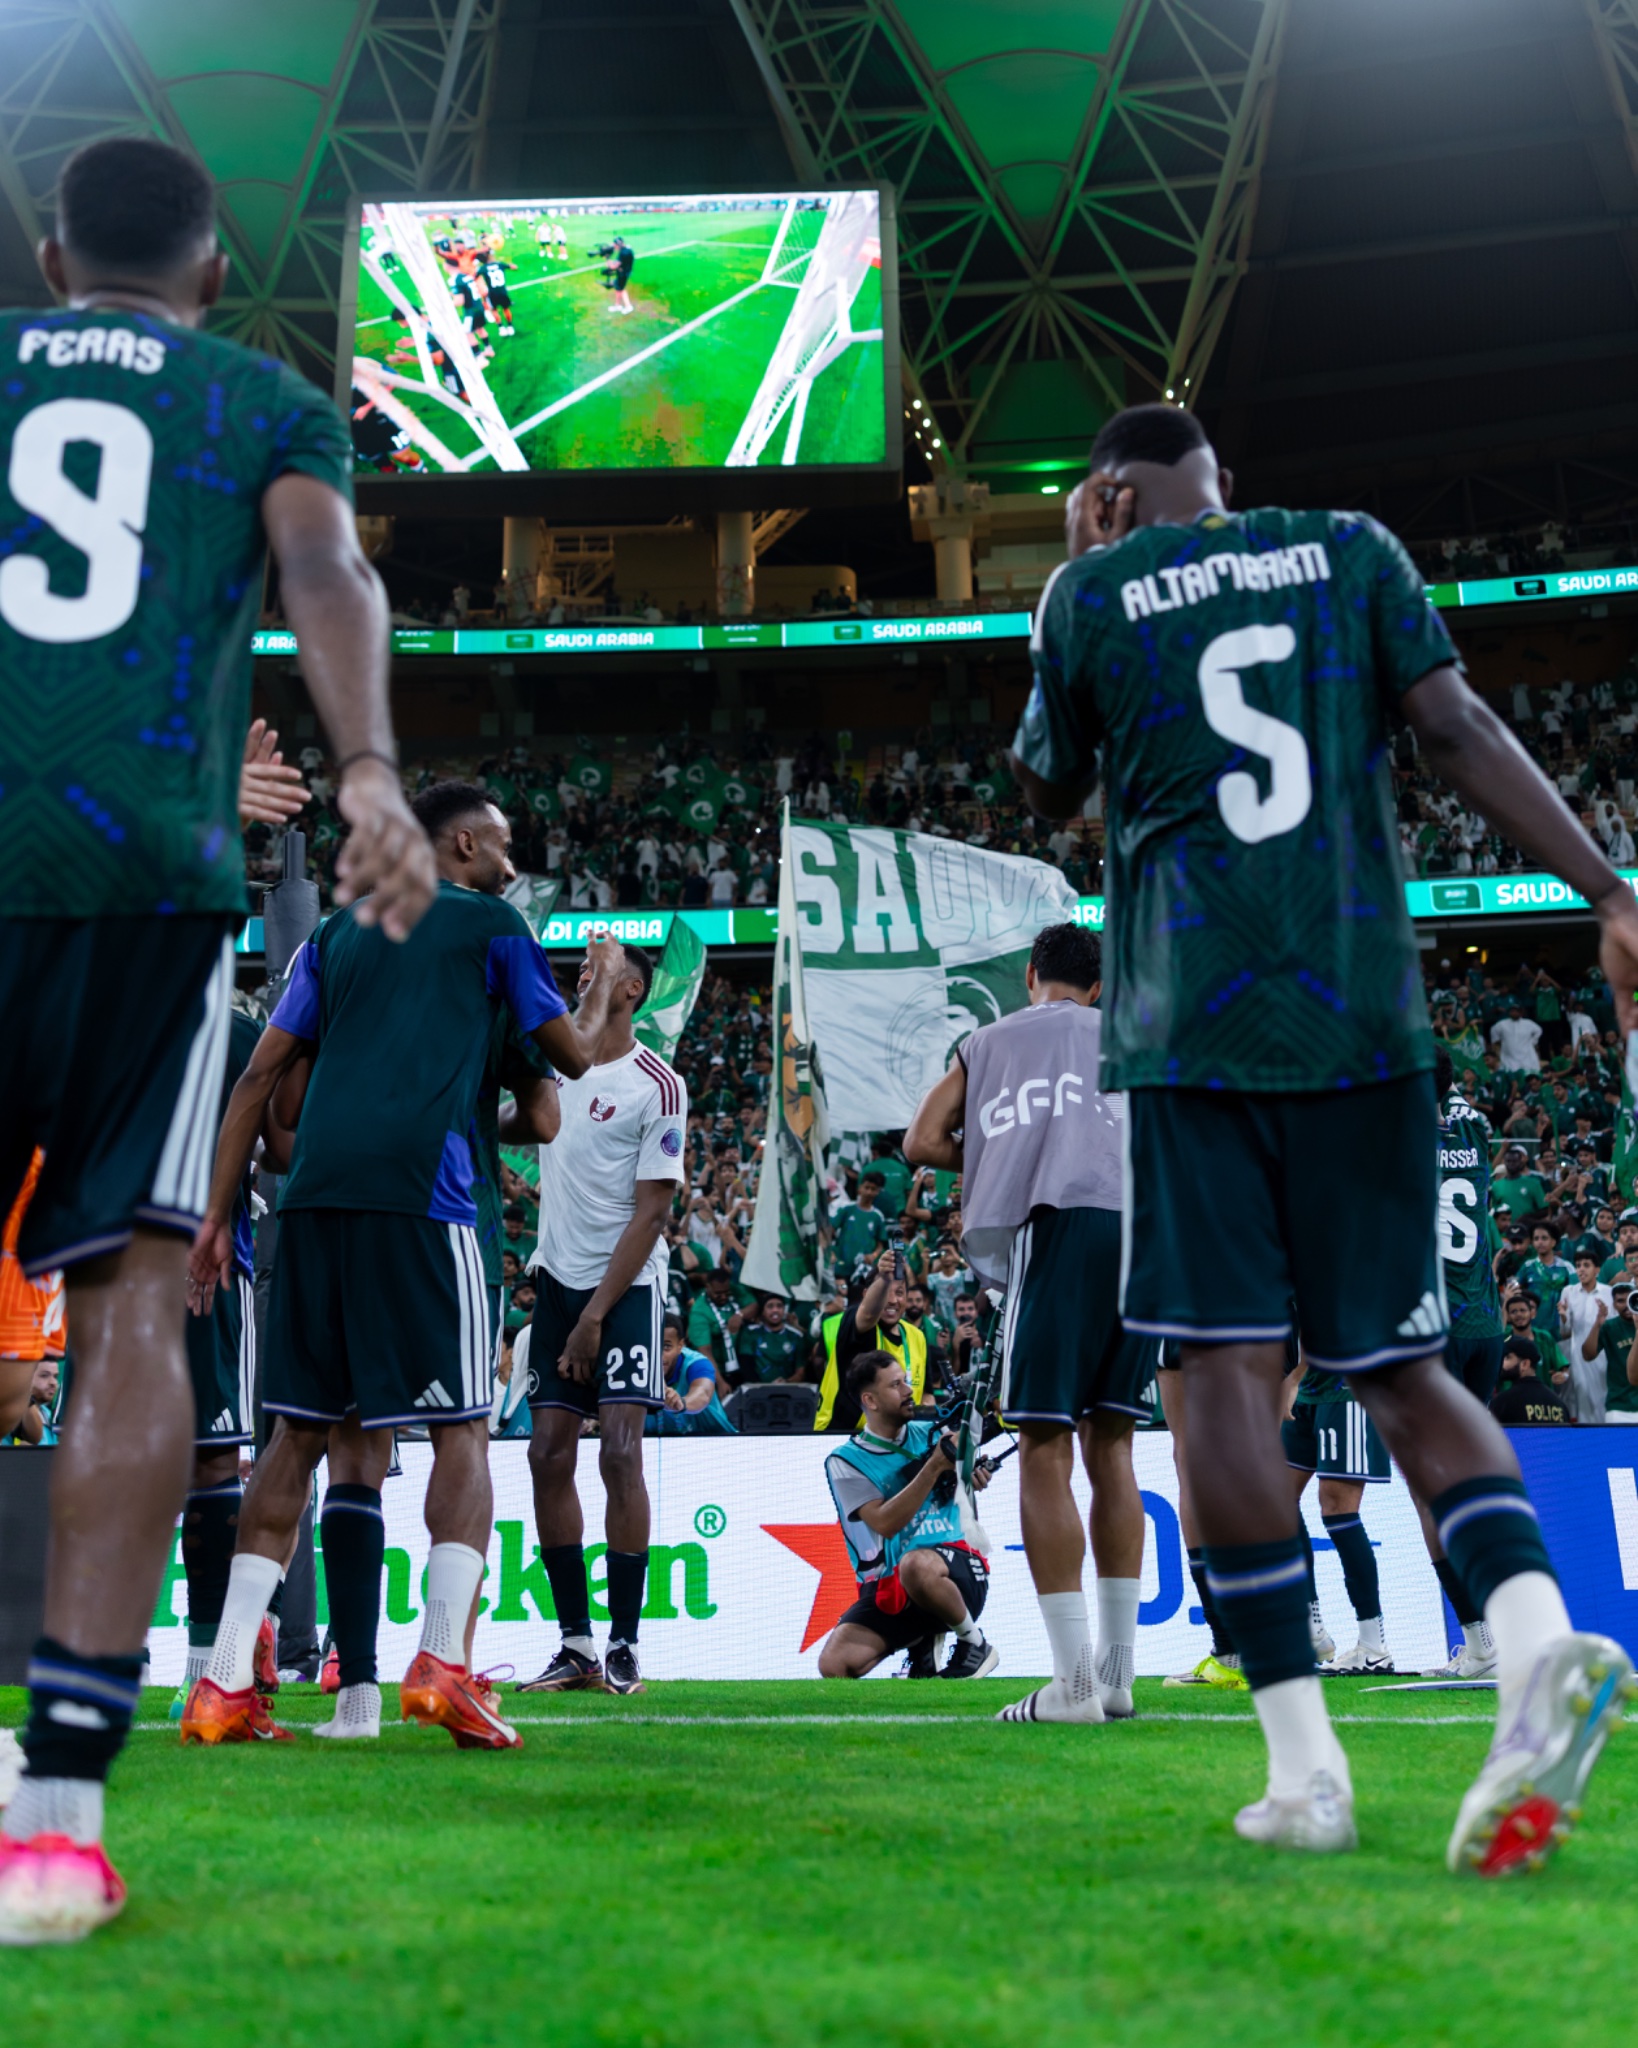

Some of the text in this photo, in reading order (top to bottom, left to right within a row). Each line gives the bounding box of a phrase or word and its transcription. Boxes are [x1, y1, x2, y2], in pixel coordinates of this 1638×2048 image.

[18, 329, 167, 374] FERAS
[0, 398, 154, 643] 9
[1557, 574, 1611, 592] SAUDI
[544, 632, 654, 648] SAUDI ARABIA
[872, 621, 983, 639] SAUDI ARABIA
[266, 636, 298, 649] ARA
[1197, 623, 1312, 845] 5
[1496, 881, 1573, 905] SAUDI
[577, 919, 662, 940] ARABIA
[1437, 1147, 1479, 1168] ASSER
[606, 1344, 648, 1390] 23
[1525, 1404, 1564, 1422] POLICE
[1318, 1427, 1338, 1461] 11
